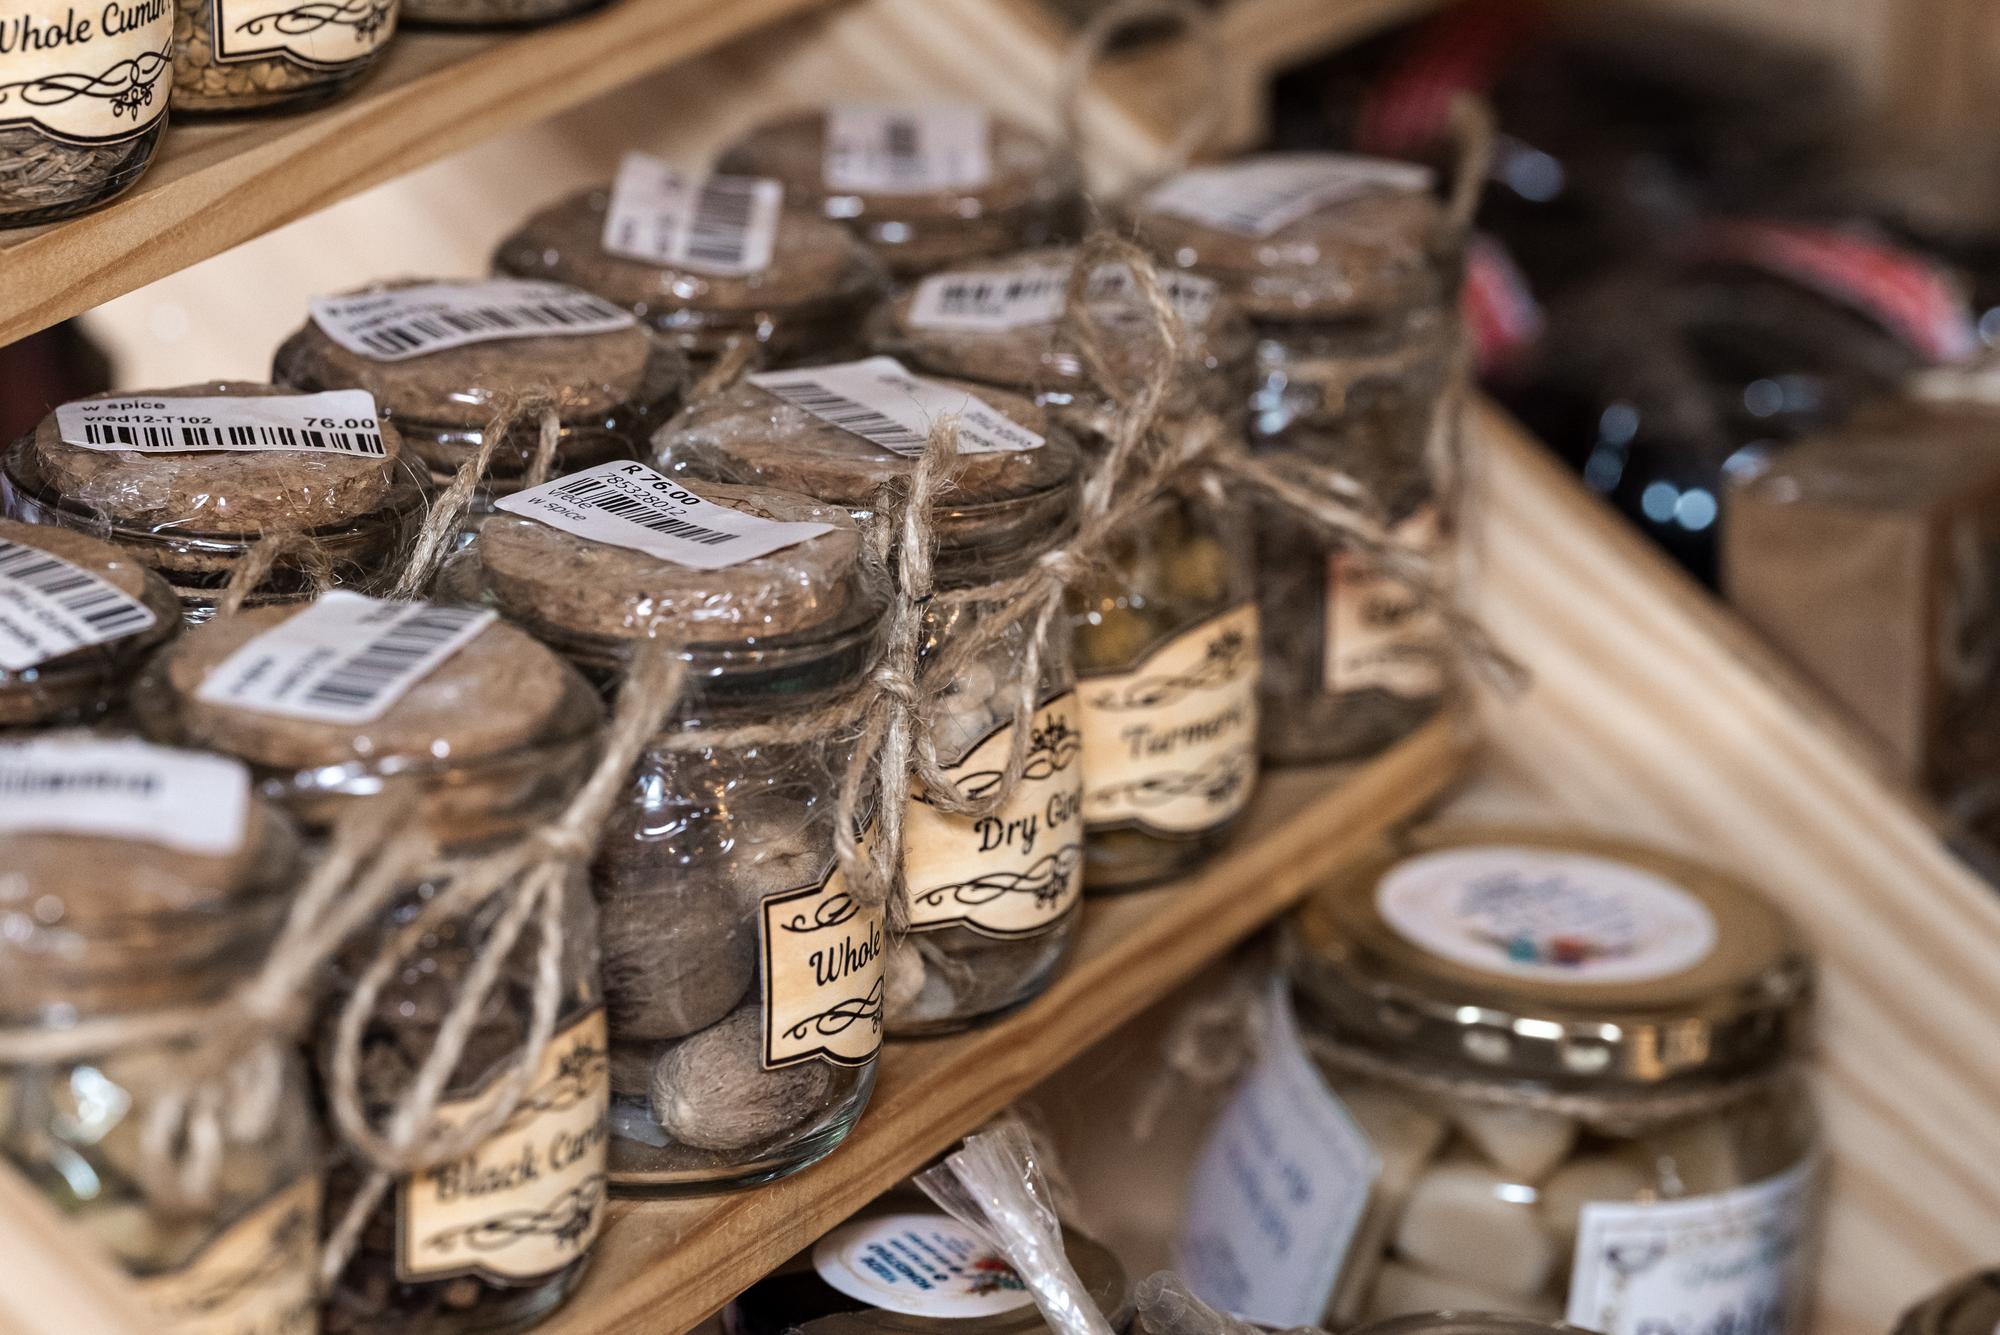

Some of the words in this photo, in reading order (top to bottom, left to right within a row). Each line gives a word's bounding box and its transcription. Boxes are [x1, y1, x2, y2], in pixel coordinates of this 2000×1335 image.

[107, 400, 167, 411] spice
[303, 416, 376, 430] 76.00
[597, 472, 687, 517] 785328012
[621, 464, 643, 475] R
[640, 473, 701, 506] 76.00
[544, 500, 587, 521] spice
[974, 814, 1036, 856] Dry
[808, 920, 881, 986] Whole
